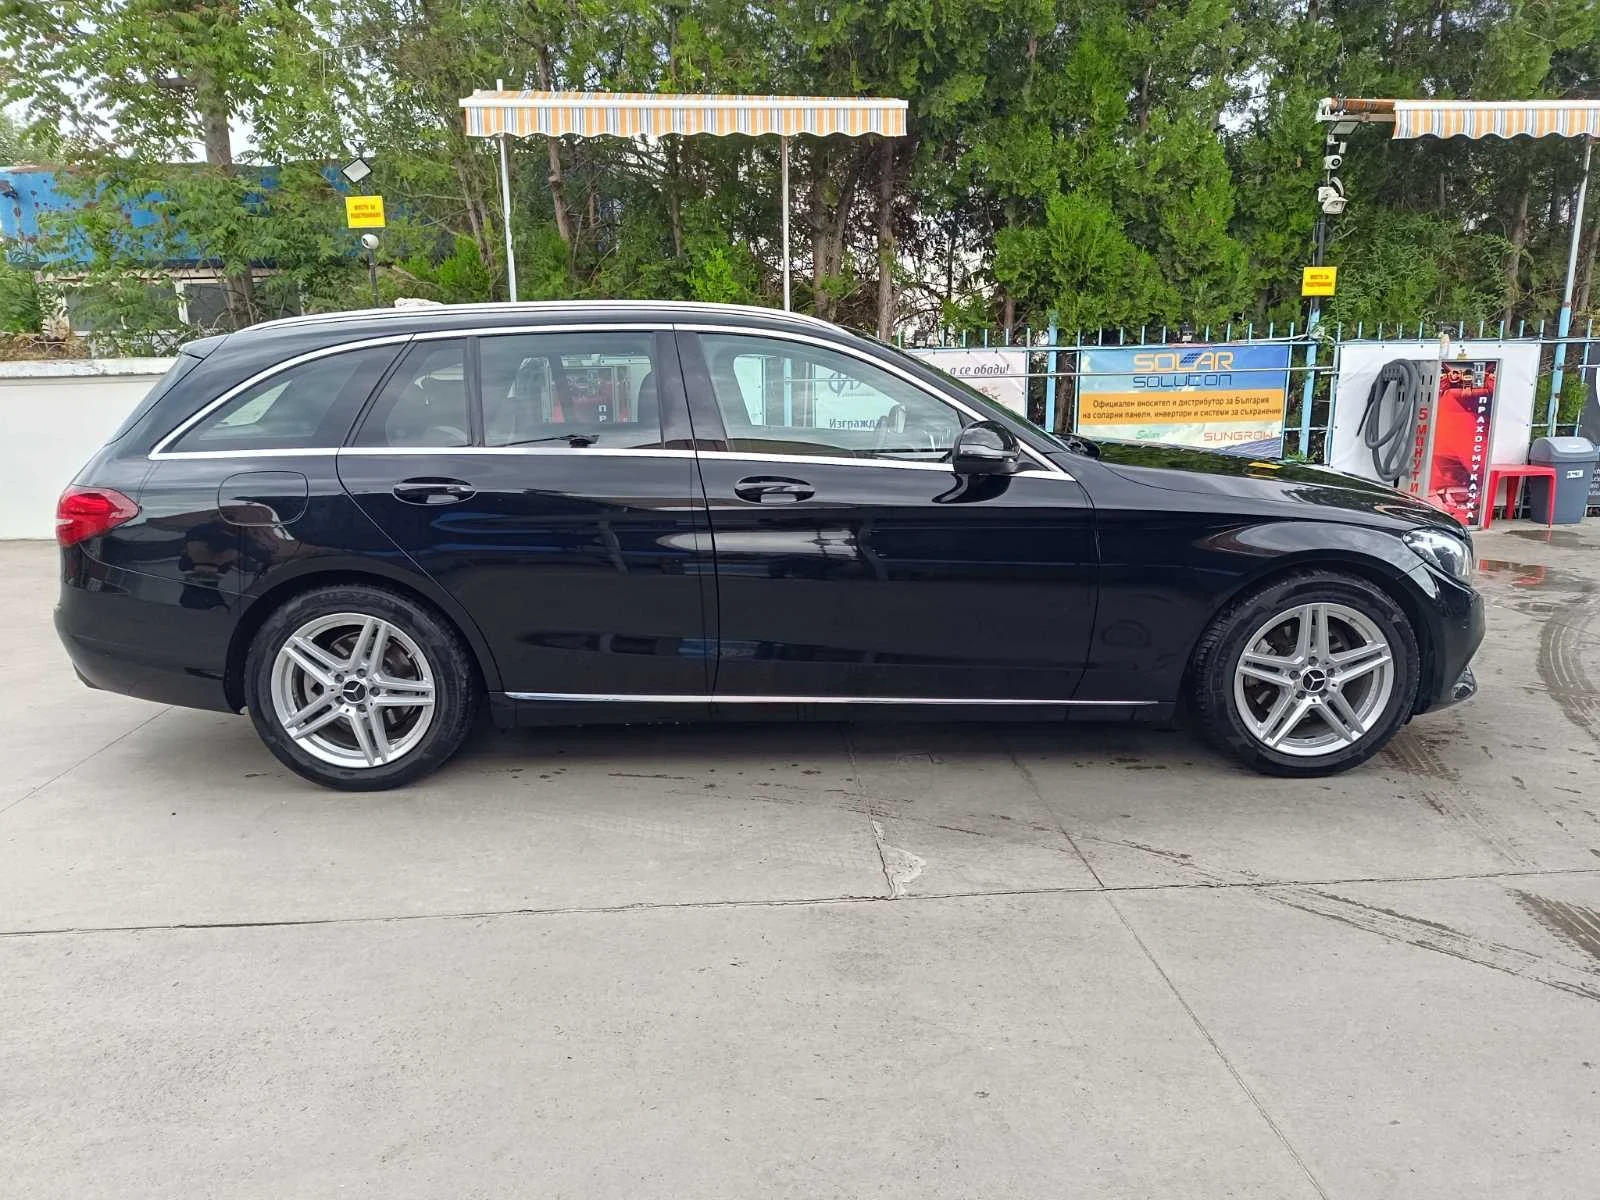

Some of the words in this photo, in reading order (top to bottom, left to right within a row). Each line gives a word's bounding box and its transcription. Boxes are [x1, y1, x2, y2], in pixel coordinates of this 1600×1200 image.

[1133, 351, 1234, 372] SOLAR
[960, 366, 971, 375] се
[973, 364, 1010, 375] обади!
[1093, 399, 1135, 409] Официален
[1137, 399, 1171, 407] вносител
[1178, 398, 1224, 408] дистрибутор
[1235, 396, 1269, 406] България
[1092, 411, 1123, 420] соларни
[1154, 410, 1192, 418] инвертори
[1200, 409, 1229, 417] системи
[1240, 408, 1281, 417] съхранение
[1418, 407, 1429, 421] 5
[1203, 431, 1273, 442] SUNGROW
[1410, 424, 1429, 493] МИНУТИ
[1465, 396, 1488, 519] ПРАХОСМУКАЧКА
